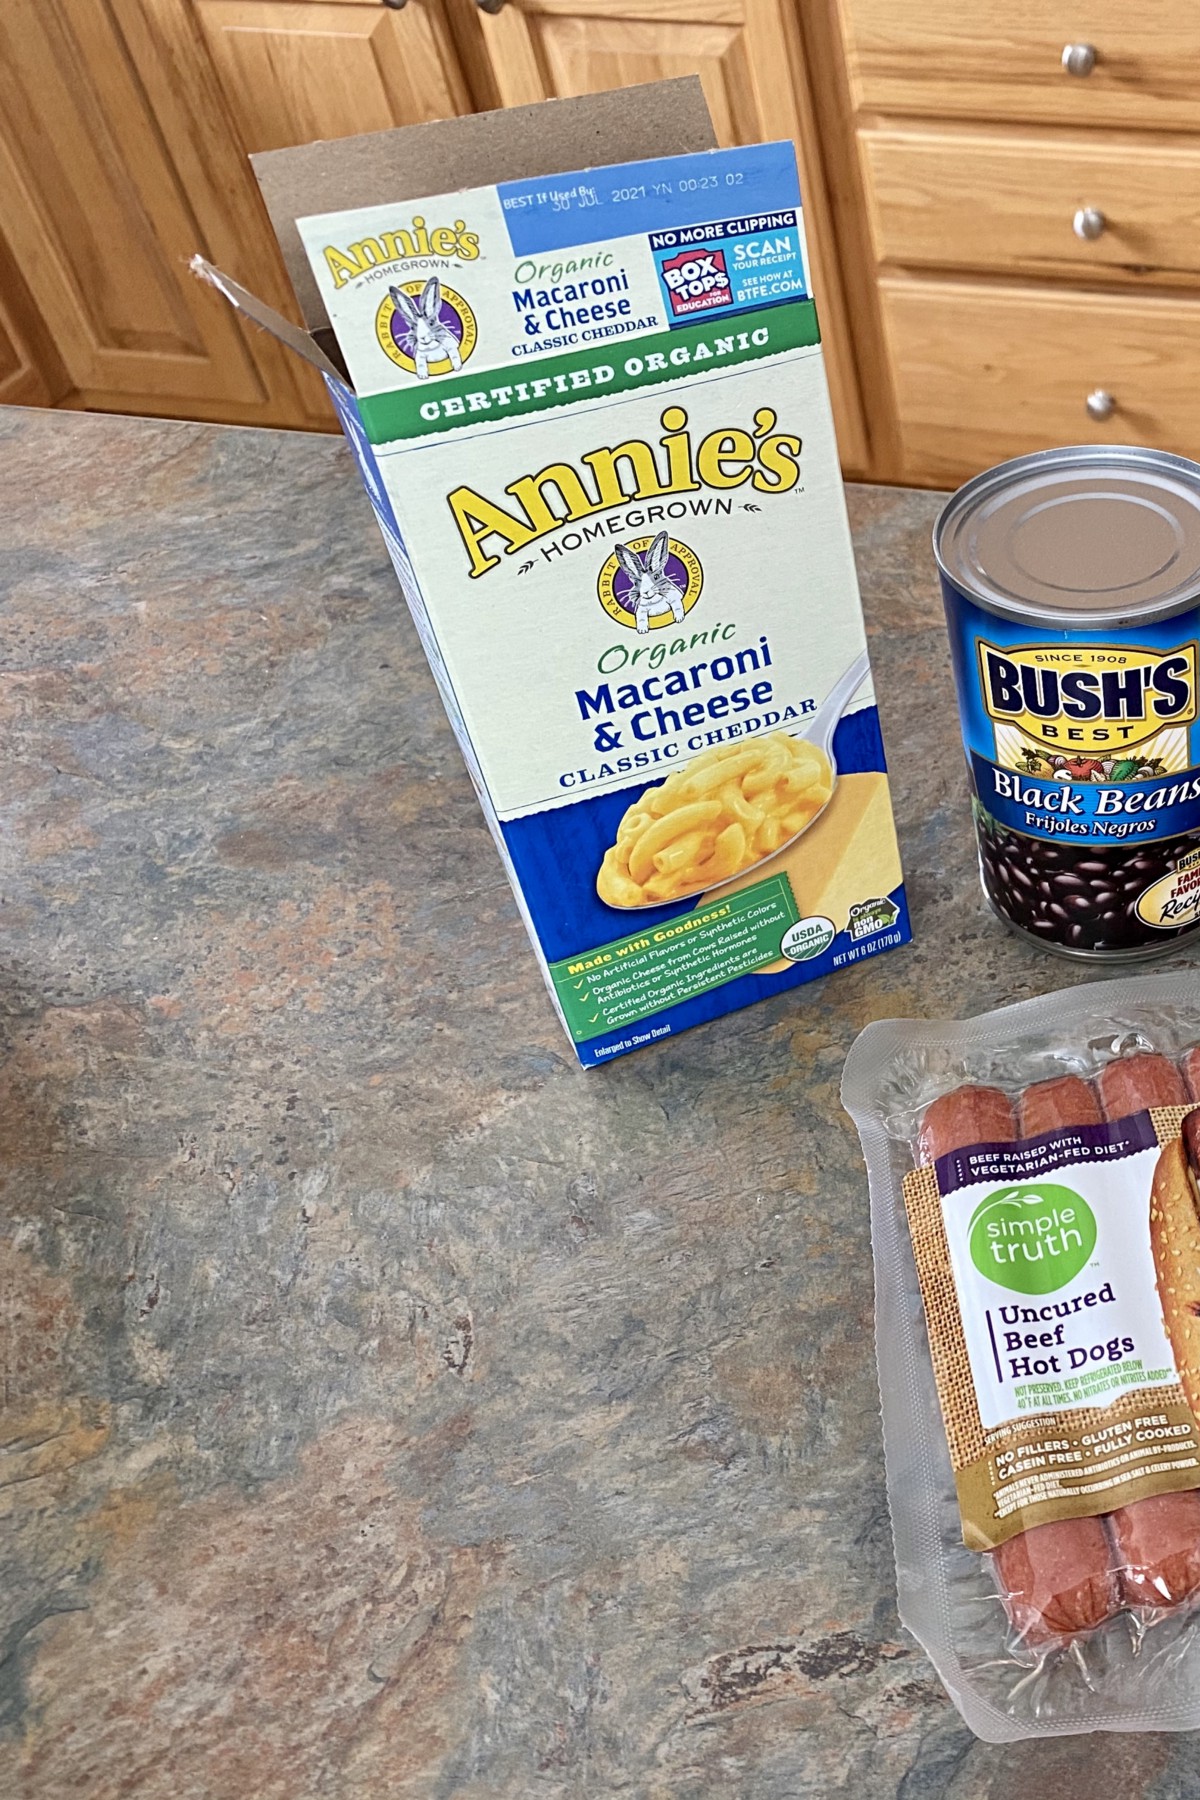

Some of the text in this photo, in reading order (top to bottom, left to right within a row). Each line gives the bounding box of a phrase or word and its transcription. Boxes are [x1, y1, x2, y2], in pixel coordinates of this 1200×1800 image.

[503, 195, 533, 210] BEST
[612, 173, 744, 203] 2021 YN 00:23 02
[652, 213, 794, 249] NO MORE CLIPPING
[733, 236, 792, 260] SCAN
[323, 216, 480, 289] Annie's
[514, 251, 614, 284] Organic
[733, 252, 797, 271] YOUR RECEIPT
[365, 259, 449, 284] HOMEGROWN
[663, 256, 719, 290] BOX
[742, 270, 793, 287] SEE HOW AT
[512, 268, 630, 312] Macaroni
[676, 294, 730, 313] EDUCATION
[737, 278, 803, 302] BTFE.COM
[524, 298, 632, 335] & Cheese
[511, 316, 659, 357] CLASSIC CHEDDAR
[419, 327, 770, 421] CERTIFIED ORGANIC
[446, 405, 803, 580] Annie's
[540, 498, 732, 563] HOMEGROWN
[602, 540, 700, 616] RABBIT OF APPROVAL
[597, 621, 736, 675] Organic
[1035, 654, 1128, 664] SINCE 1908
[574, 636, 774, 720] Macaroni
[986, 651, 1190, 721] BUSH'S
[594, 680, 774, 755] & Cheese
[1041, 724, 1135, 741] BEST
[559, 698, 818, 789] CLASSIC CHEDDAR
[991, 767, 1083, 815] Black
[1025, 811, 1156, 837] Frijoles Negros
[851, 899, 886, 917] Organic
[854, 915, 874, 928] non
[567, 905, 732, 975] Made with Goodness!
[586, 901, 777, 985] No Artificial Flavors or Synthetic Colors
[790, 934, 829, 955] ORGANIC
[791, 924, 823, 942] USDA
[855, 918, 883, 938] GMO
[592, 911, 785, 998] Organic Cheese from Cows Raised without
[597, 934, 758, 1005] Antibiotics or Synthetic Hormones
[833, 948, 860, 967] NET WT
[602, 948, 758, 1017] Certified Organic Ingredients are
[606, 950, 774, 1025] Grown without Persistent Pesticides
[594, 1024, 671, 1058] Enlarged Show Detail
[969, 1136, 1081, 1165] BEEF RAISED WITH
[971, 1147, 1090, 1176] VEGETARIAN-FED
[986, 1207, 1076, 1238] simple
[990, 1227, 1083, 1264] truth
[999, 1282, 1116, 1325] Uncured
[1003, 1324, 1065, 1351] Beef
[1009, 1336, 1135, 1378] Hot Dogs
[1064, 1360, 1143, 1390] KEEP REFRIGERATED BELOW
[984, 1417, 1057, 1445] SERVING SUGGESTION
[996, 1415, 1169, 1467] NO FILLERS GLUTEN FREE
[999, 1424, 1191, 1480] CASEIN FREE FULLY COOKED
